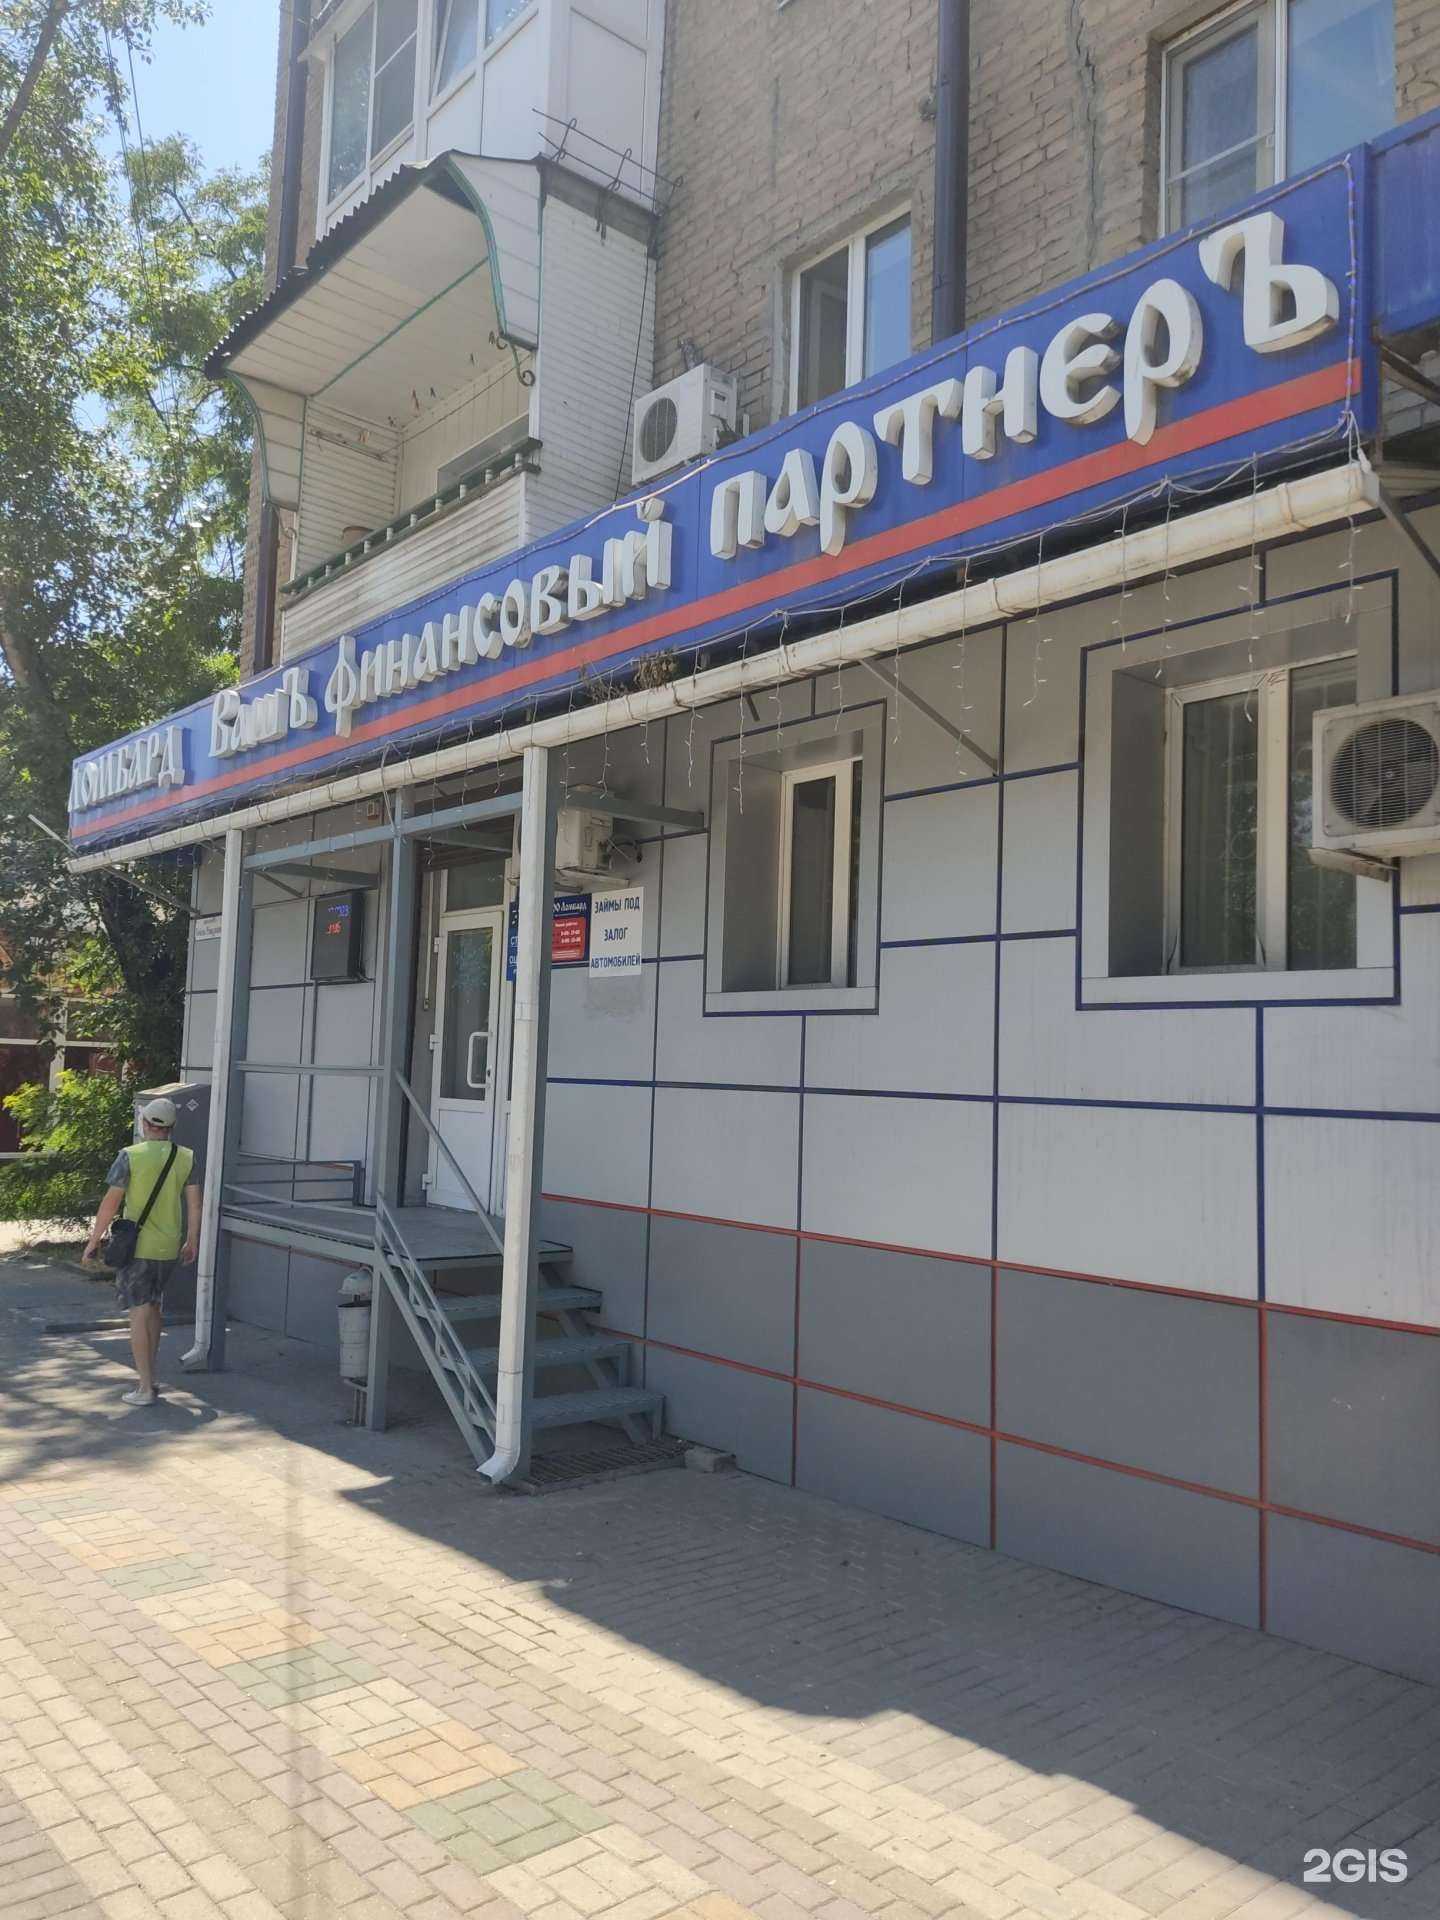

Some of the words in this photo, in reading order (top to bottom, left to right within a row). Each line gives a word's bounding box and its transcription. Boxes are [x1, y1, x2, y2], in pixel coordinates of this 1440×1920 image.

[595, 898, 622, 914] ЗАЙМЫ
[624, 896, 640, 912] ПОД
[603, 927, 629, 942] ЗАЛОГ
[590, 953, 641, 969] АВТОМОБИЛЕЙ
